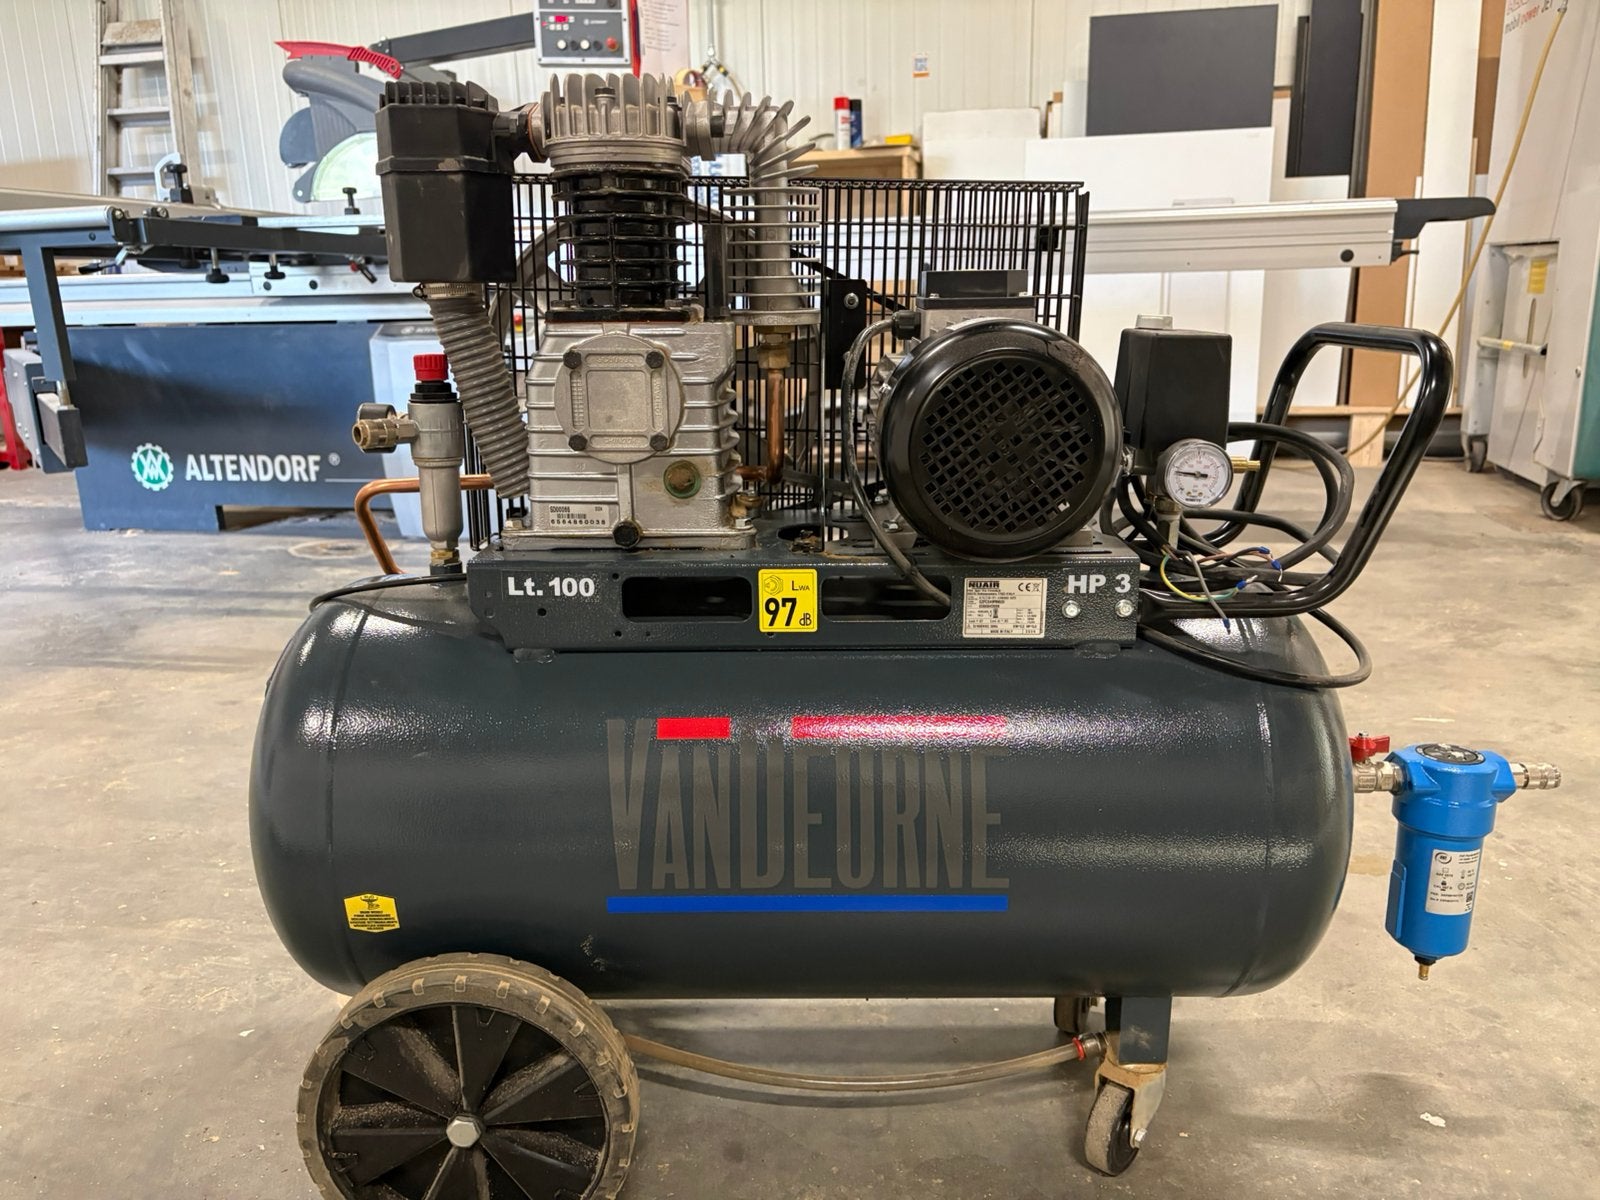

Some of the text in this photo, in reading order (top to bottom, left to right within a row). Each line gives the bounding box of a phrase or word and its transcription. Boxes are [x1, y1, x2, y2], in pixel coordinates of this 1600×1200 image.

[185, 453, 321, 482] ALTENDORF
[507, 576, 595, 597] Lt. 100
[968, 580, 1000, 589] NUAIR
[1067, 573, 1131, 594] HP 3
[764, 597, 797, 627] 97
[798, 612, 812, 627] dB
